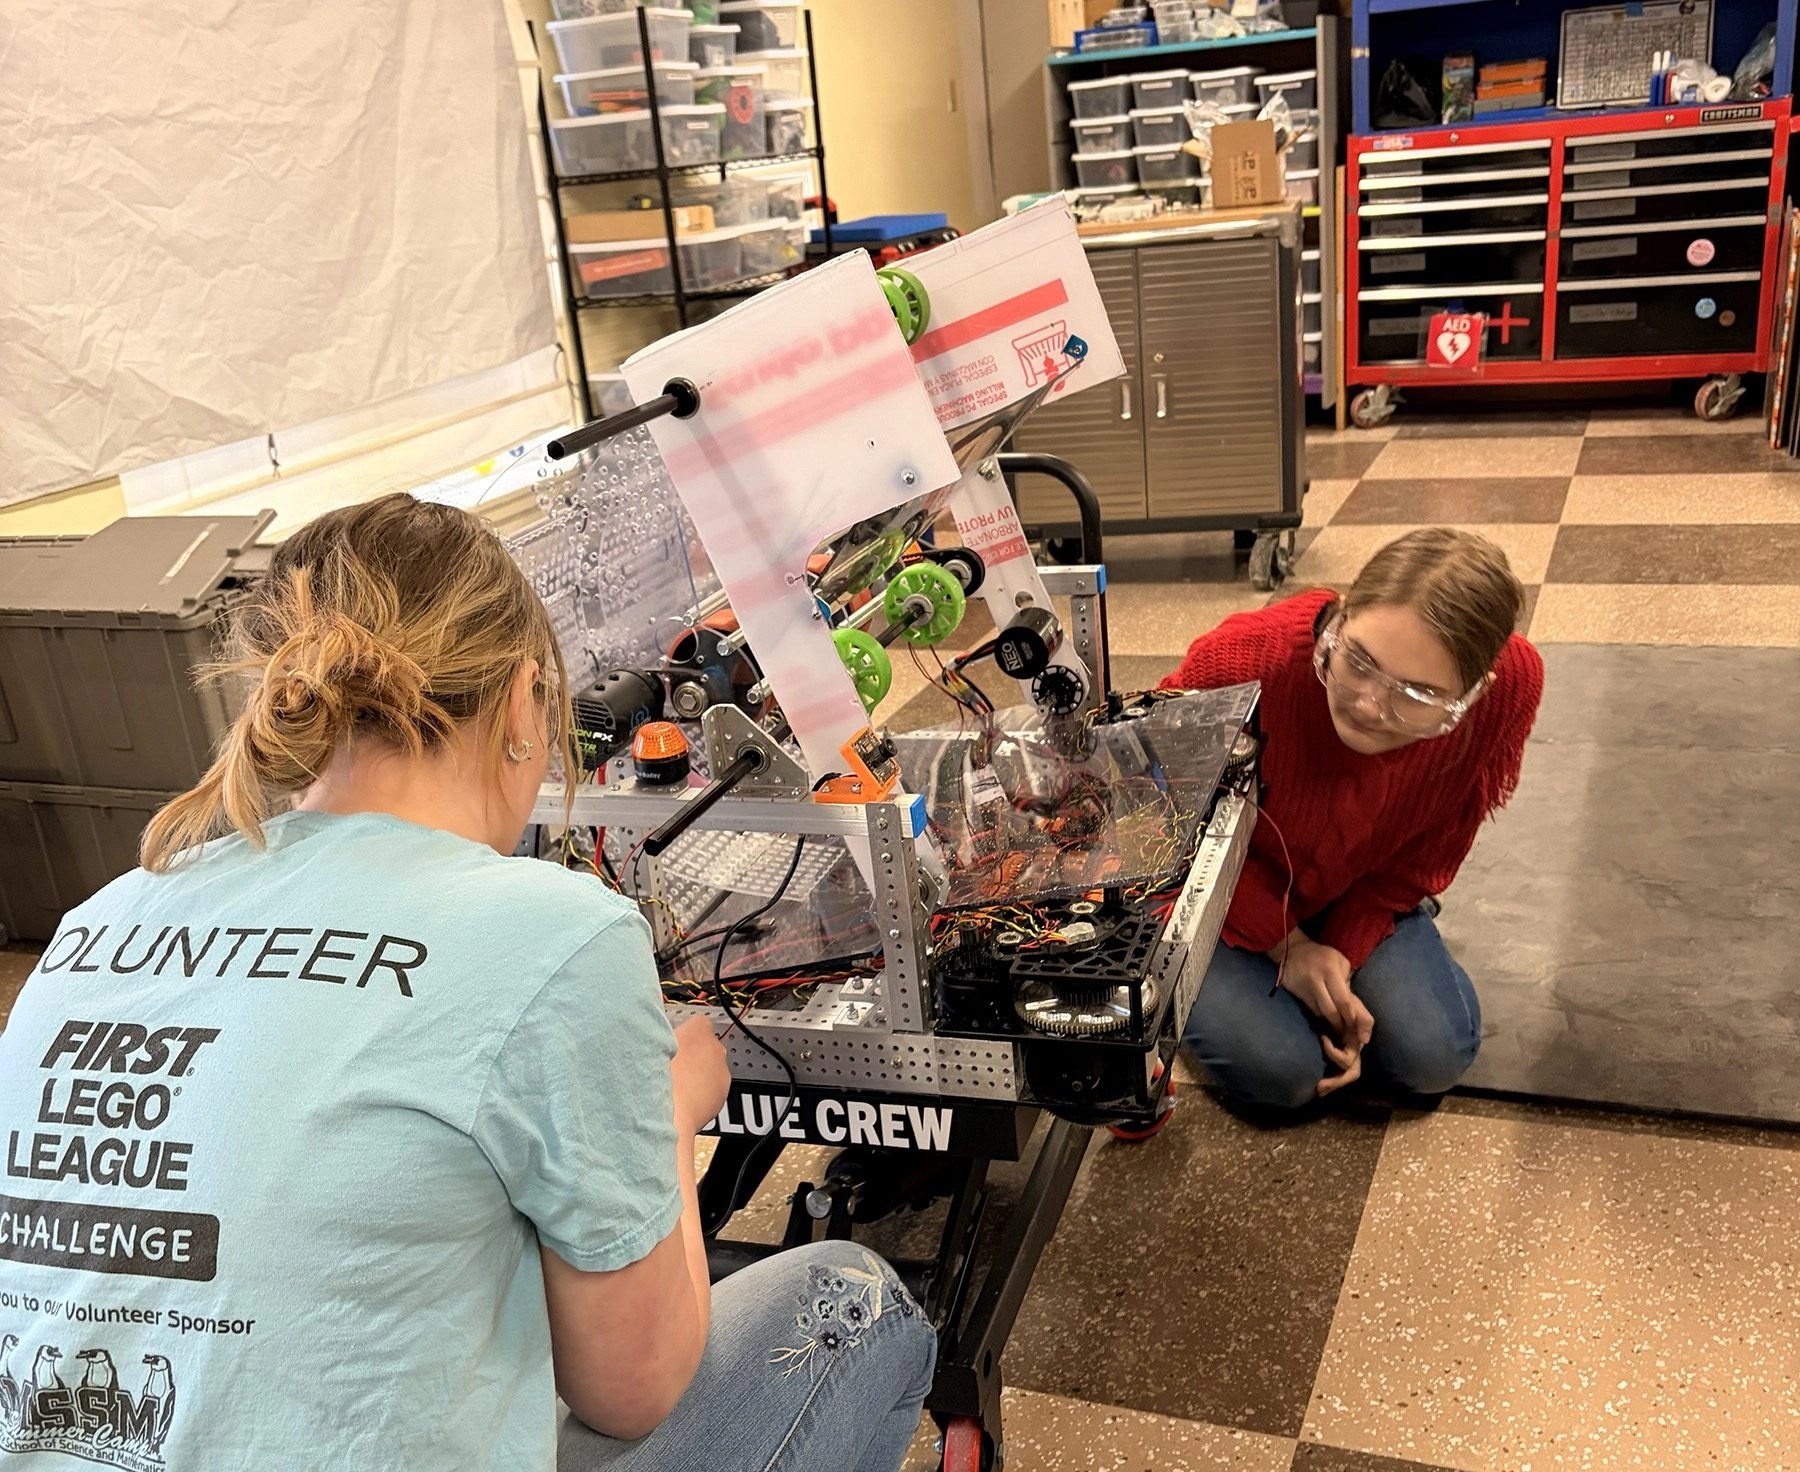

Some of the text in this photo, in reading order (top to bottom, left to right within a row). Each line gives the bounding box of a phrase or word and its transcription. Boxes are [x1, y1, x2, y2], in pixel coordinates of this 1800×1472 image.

[1704, 107, 1760, 121] CRAFTSMAN
[1443, 318, 1470, 332] AED
[979, 355, 995, 367] CON
[964, 364, 998, 382] ESPECIAL
[940, 378, 963, 392] PLACA
[975, 382, 1005, 396] MILLING
[979, 391, 1008, 408] SPECIAL
[997, 505, 1014, 521] UV
[967, 522, 1018, 547] ARBONATE
[1002, 642, 1021, 671] NEO
[40, 925, 428, 998] OLUNTEER
[702, 1093, 953, 1151] LUE CREW
[7, 1130, 194, 1191] LEAGUE
[0, 1211, 193, 1262] CHALLENGE
[0, 1292, 256, 1335] ou to our Volunteer Sponsor
[45, 1438, 56, 1449] of
[60, 1439, 94, 1457] Science
[96, 1448, 114, 1461] and
